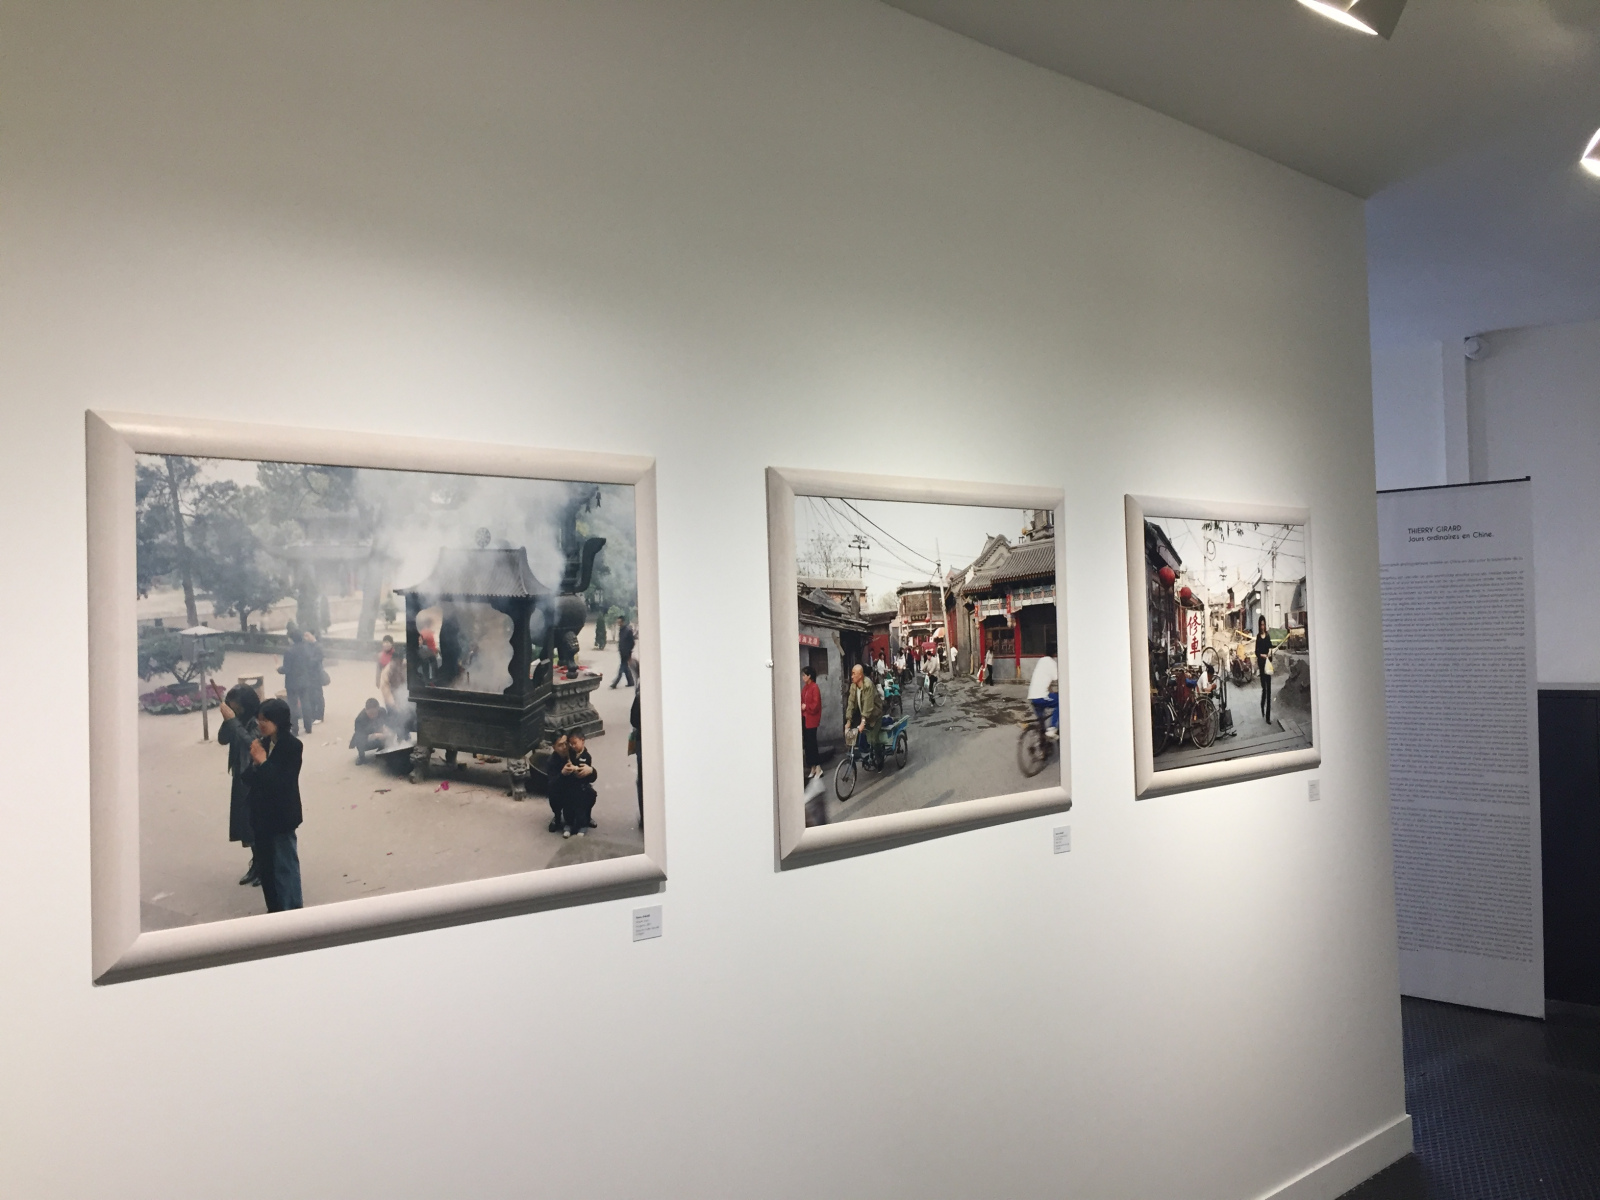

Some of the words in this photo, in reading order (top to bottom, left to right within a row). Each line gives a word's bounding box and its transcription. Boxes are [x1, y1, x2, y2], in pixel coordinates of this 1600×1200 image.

[1408, 527, 1434, 535] THIERRY
[1436, 525, 1462, 533] GIRARD
[1427, 534, 1460, 542] ordinaires
